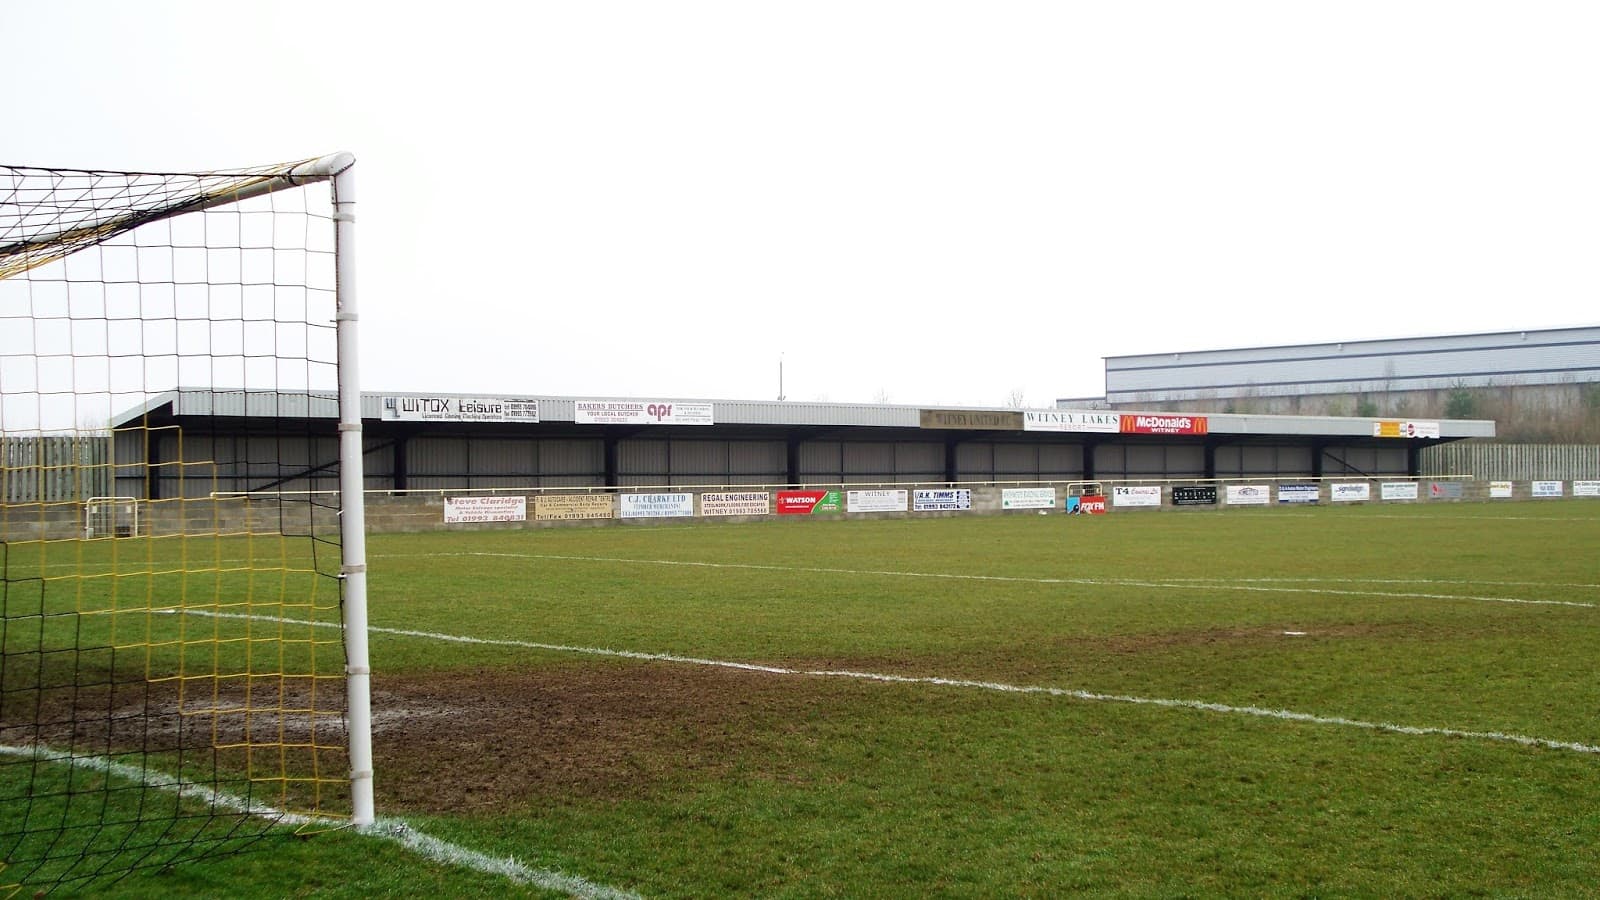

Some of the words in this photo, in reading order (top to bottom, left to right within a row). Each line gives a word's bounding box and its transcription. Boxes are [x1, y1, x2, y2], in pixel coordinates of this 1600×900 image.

[459, 399, 501, 413] Leisure
[647, 404, 672, 421] apr
[1026, 413, 1074, 423] WITNEY
[1082, 414, 1118, 424] LAKES
[1136, 416, 1191, 428] McDonald's
[933, 491, 954, 499] TIMMS
[1115, 487, 1129, 495] T4
[480, 497, 523, 506] Claridge
[703, 494, 724, 502] REGAL
[725, 493, 768, 501] ENGINEERING
[1080, 502, 1095, 511] FOX
